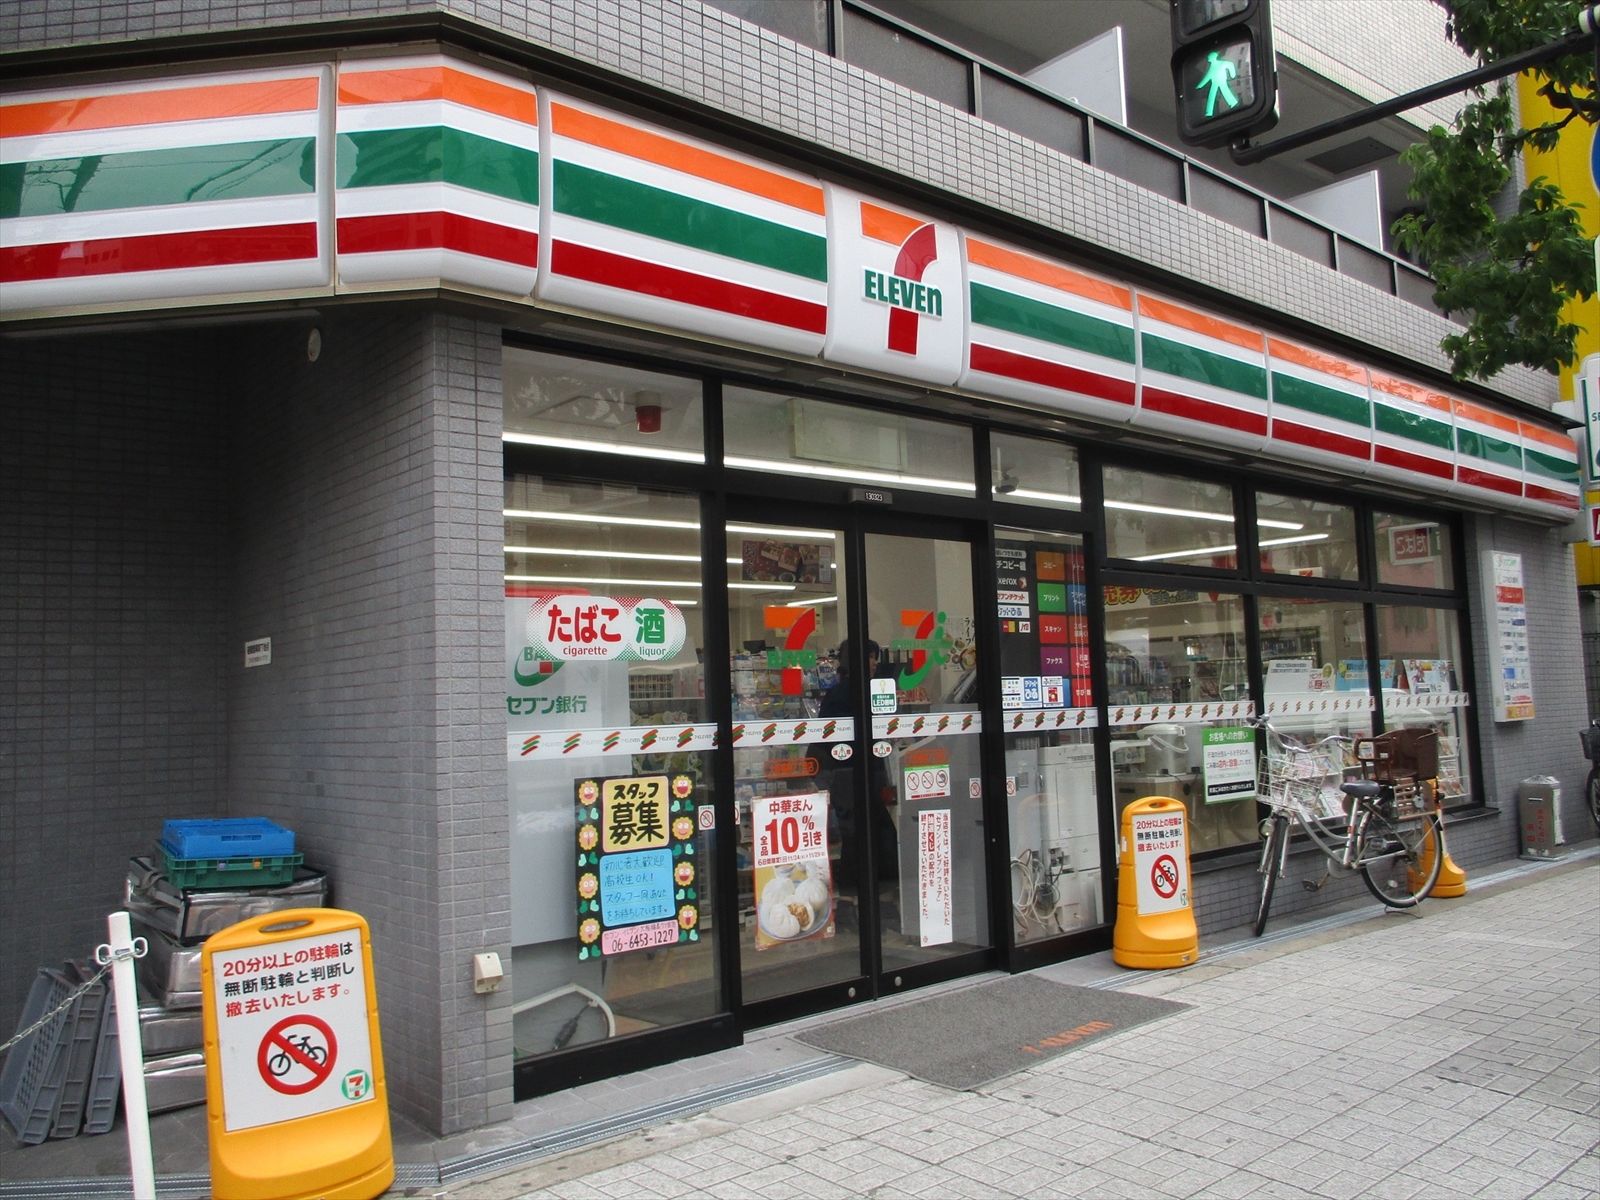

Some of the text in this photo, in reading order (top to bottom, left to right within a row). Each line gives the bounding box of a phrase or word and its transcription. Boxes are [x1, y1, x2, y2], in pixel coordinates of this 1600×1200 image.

[547, 604, 666, 644] たばこ 酒
[563, 646, 666, 657] cigarette liquor
[506, 695, 587, 716] セブン銀行
[613, 782, 660, 800] スタッフ
[768, 799, 813, 816] 中華まん
[609, 800, 665, 845] 募集
[1136, 817, 1182, 830] 20分以上の駐輪は
[765, 815, 815, 855] 10 %
[802, 831, 823, 848] 引き
[1137, 827, 1183, 841] 無断駐輪と判断し
[760, 835, 769, 856] 全品
[222, 941, 354, 977] 20分以上の駐輪は
[224, 961, 355, 997] 無断駐輪と判断し
[225, 983, 350, 1018] 撤去いたします。
